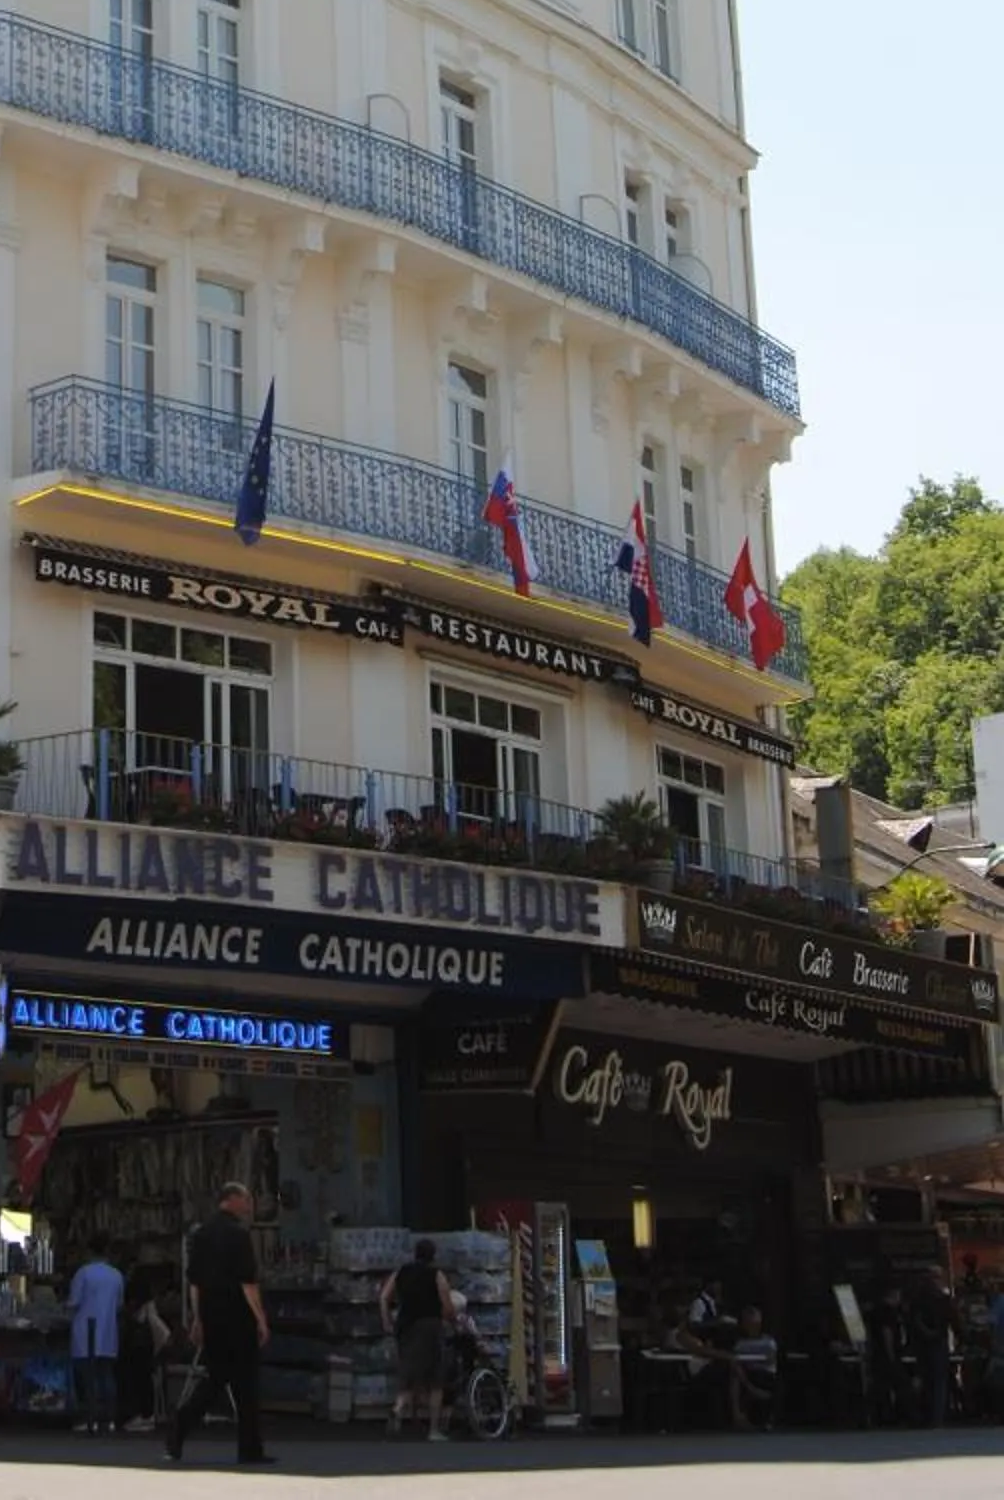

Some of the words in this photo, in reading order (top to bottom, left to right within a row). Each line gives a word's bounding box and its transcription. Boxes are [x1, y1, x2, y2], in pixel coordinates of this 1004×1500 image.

[39, 558, 152, 596] BRASSERIE
[168, 574, 340, 629] ROYAL
[430, 612, 605, 678] RESTAURANT
[661, 697, 742, 746] ROYAL
[15, 820, 275, 902] ALLIANCE
[315, 853, 602, 937] CATHOLIQUE
[86, 916, 263, 965] ALLIANCE
[299, 933, 505, 987] CATHOLIQUE
[853, 950, 911, 995] Brasserie
[12, 995, 145, 1037] ALLIANCE
[166, 1010, 334, 1052] CATHOLIQUE
[745, 988, 787, 1025] Café
[793, 998, 848, 1032] Royal
[659, 1059, 735, 1151] Royal
